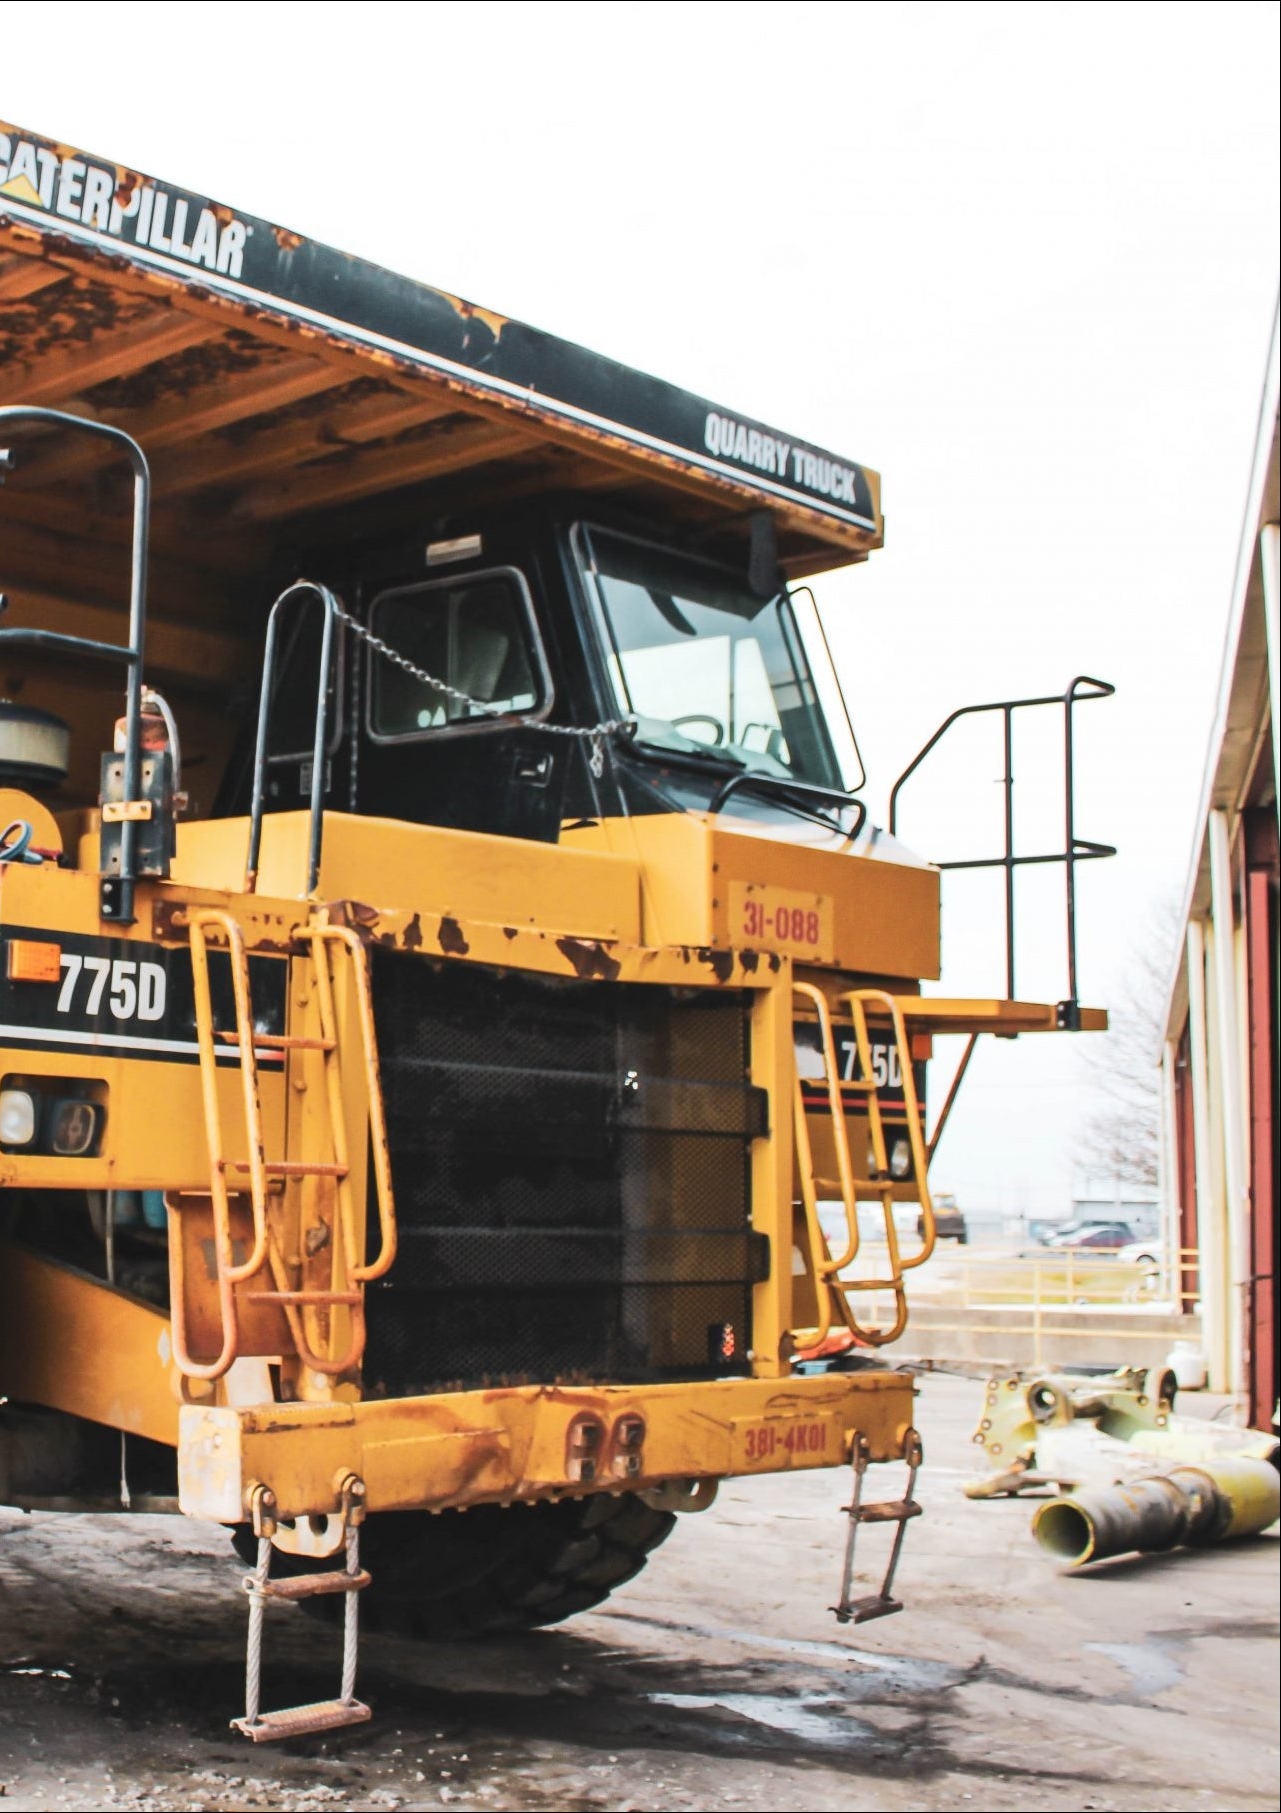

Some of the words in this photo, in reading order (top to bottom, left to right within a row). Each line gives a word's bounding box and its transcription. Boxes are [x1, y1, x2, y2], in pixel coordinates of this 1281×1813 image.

[704, 412, 790, 477] QUARRY
[791, 446, 856, 505] TRUCK
[743, 901, 819, 945] 31-088
[56, 953, 167, 1021] 775D
[841, 1041, 903, 1088] 75D
